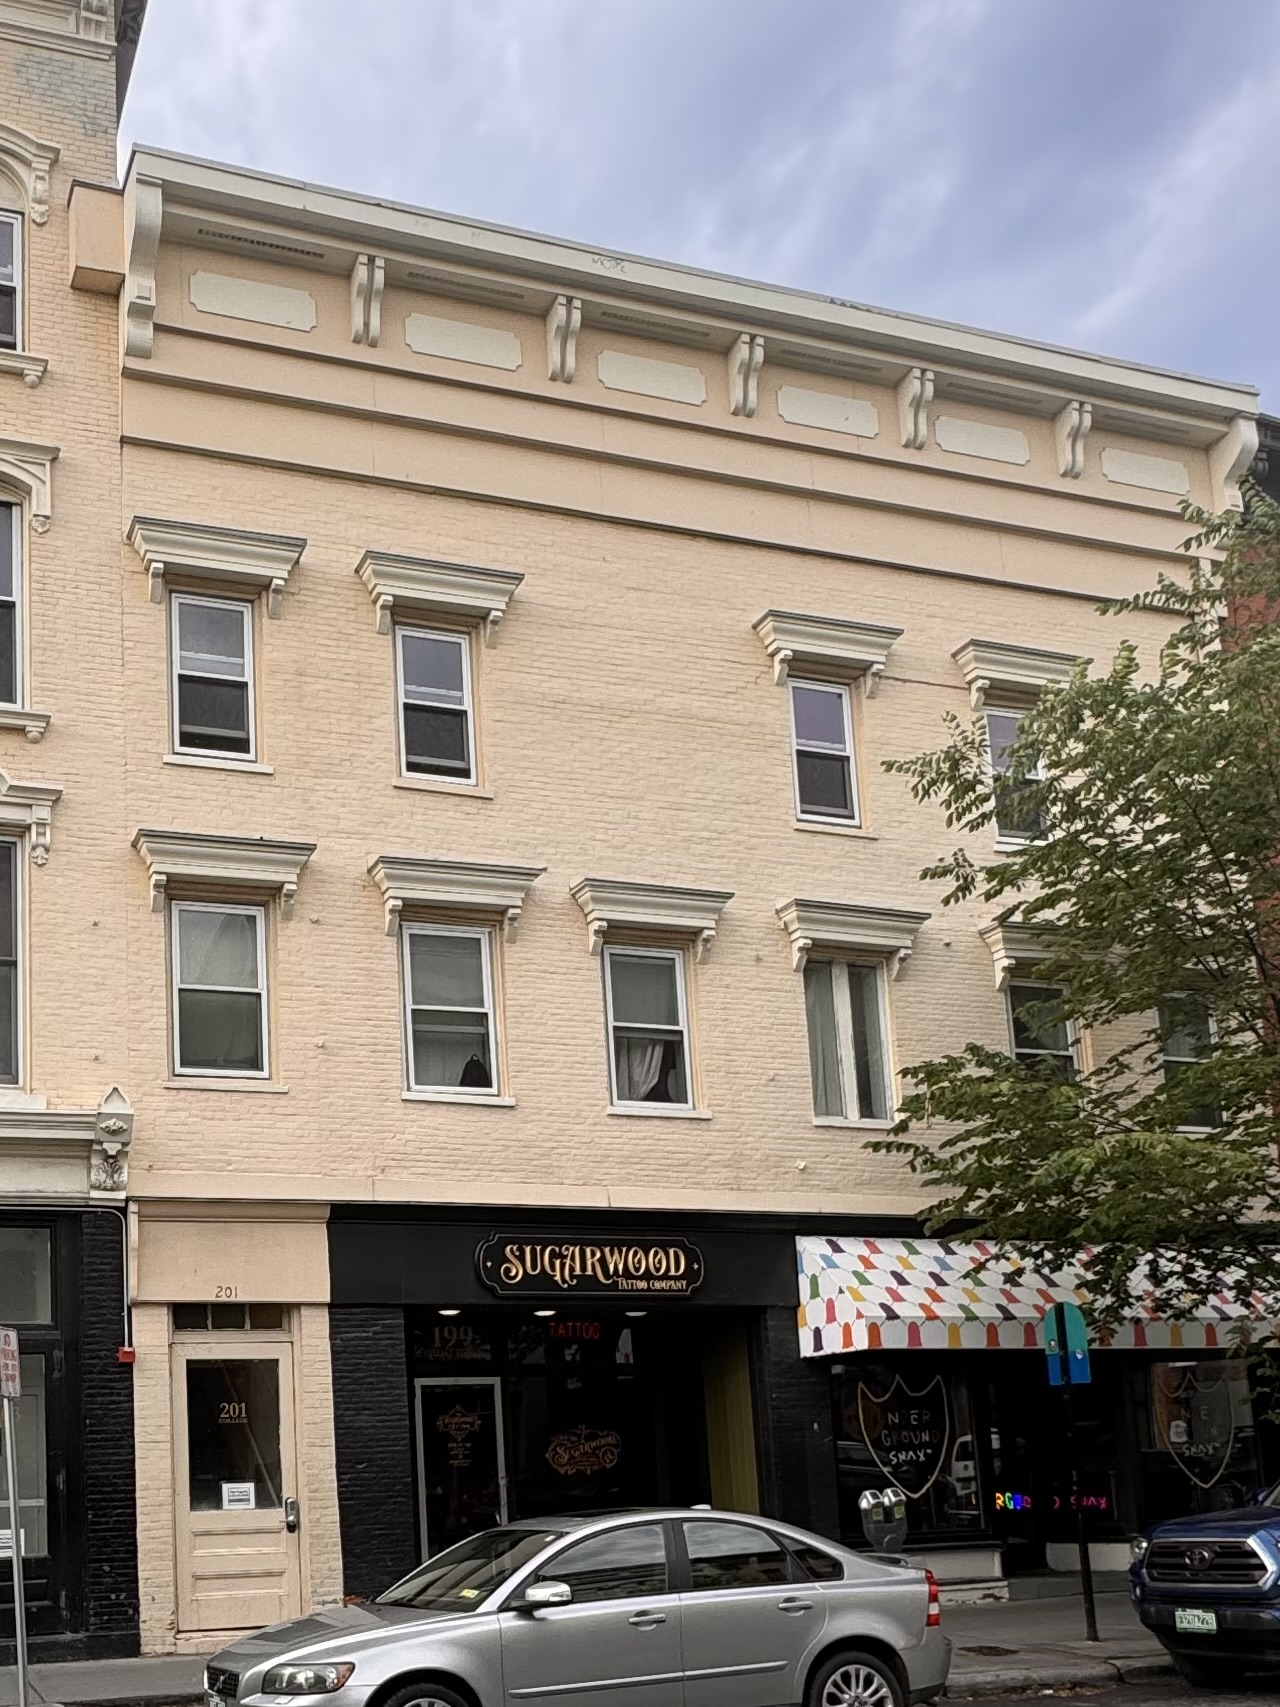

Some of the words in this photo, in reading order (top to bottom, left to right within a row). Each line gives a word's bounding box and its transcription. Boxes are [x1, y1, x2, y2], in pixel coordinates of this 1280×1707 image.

[501, 1244, 686, 1288] SUGARWOOD
[215, 1286, 238, 1299] 201
[650, 1279, 687, 1290] COMPANY
[433, 1325, 473, 1349] 199
[548, 1322, 601, 1340] TATTOO
[219, 1402, 248, 1418] 201
